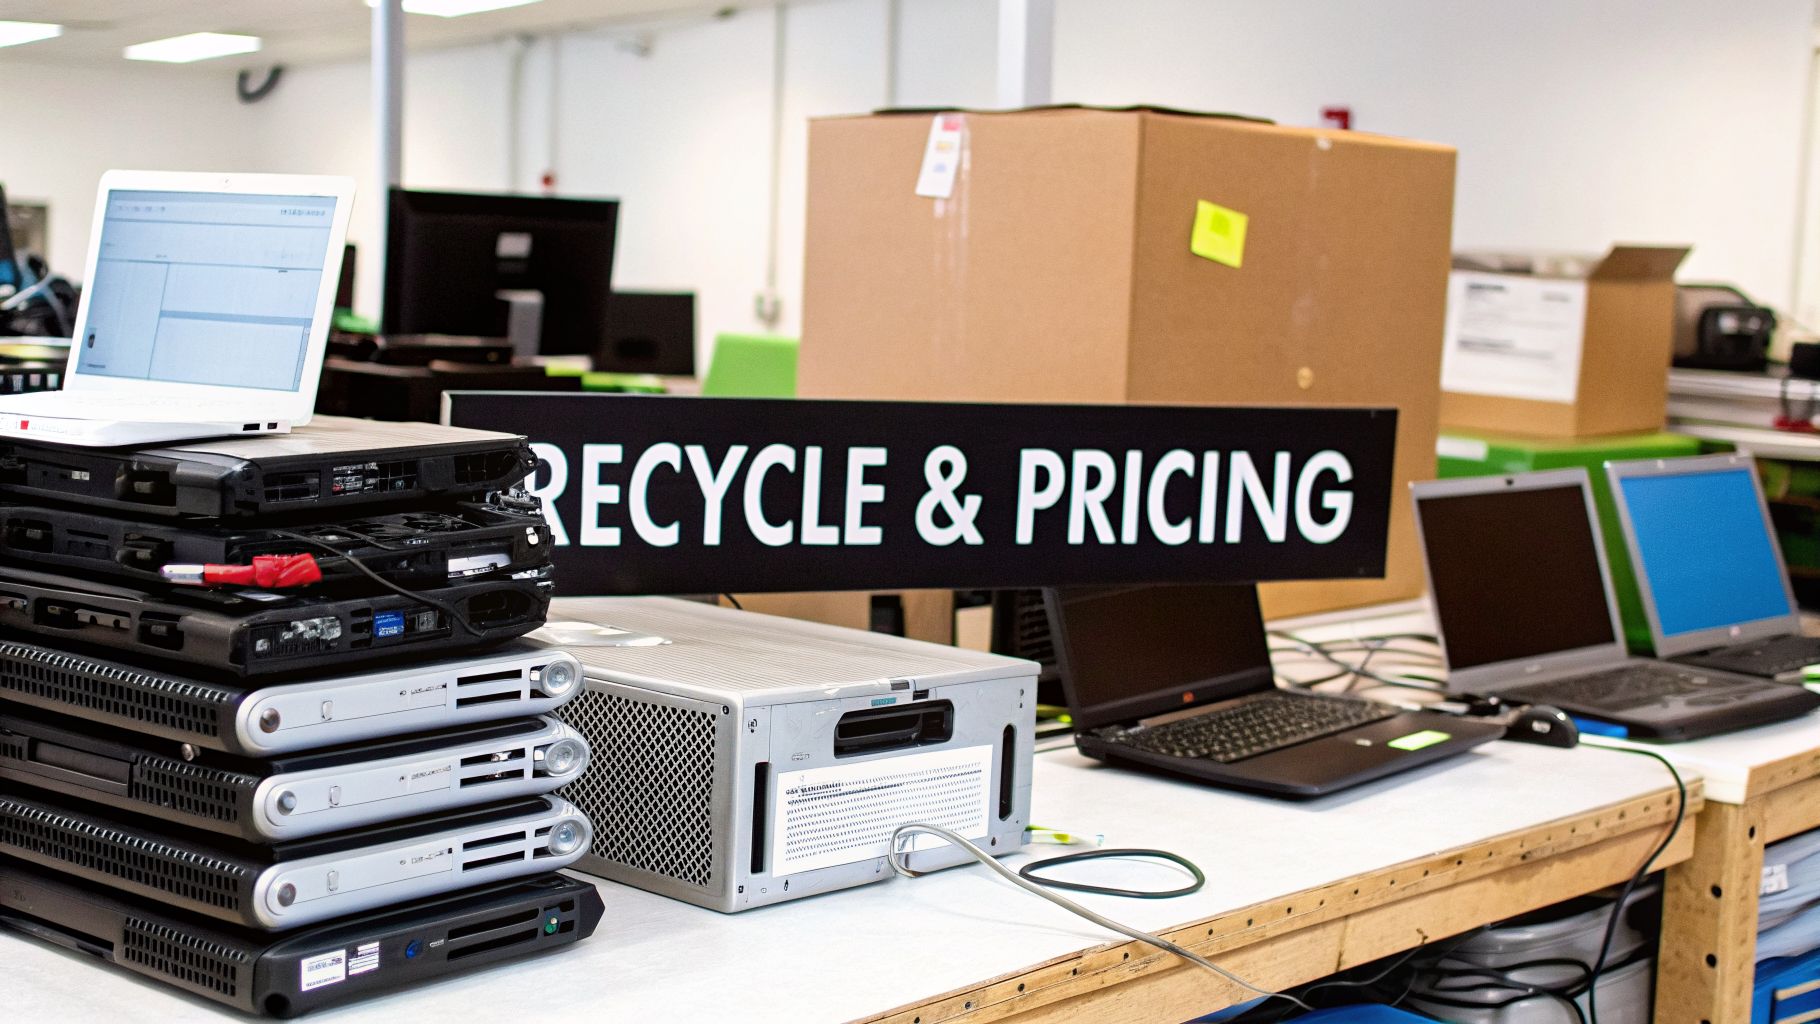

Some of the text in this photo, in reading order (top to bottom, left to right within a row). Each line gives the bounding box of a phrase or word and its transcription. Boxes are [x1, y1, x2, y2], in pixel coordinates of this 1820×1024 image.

[525, 442, 1355, 546] RECYCLE & PRICING
